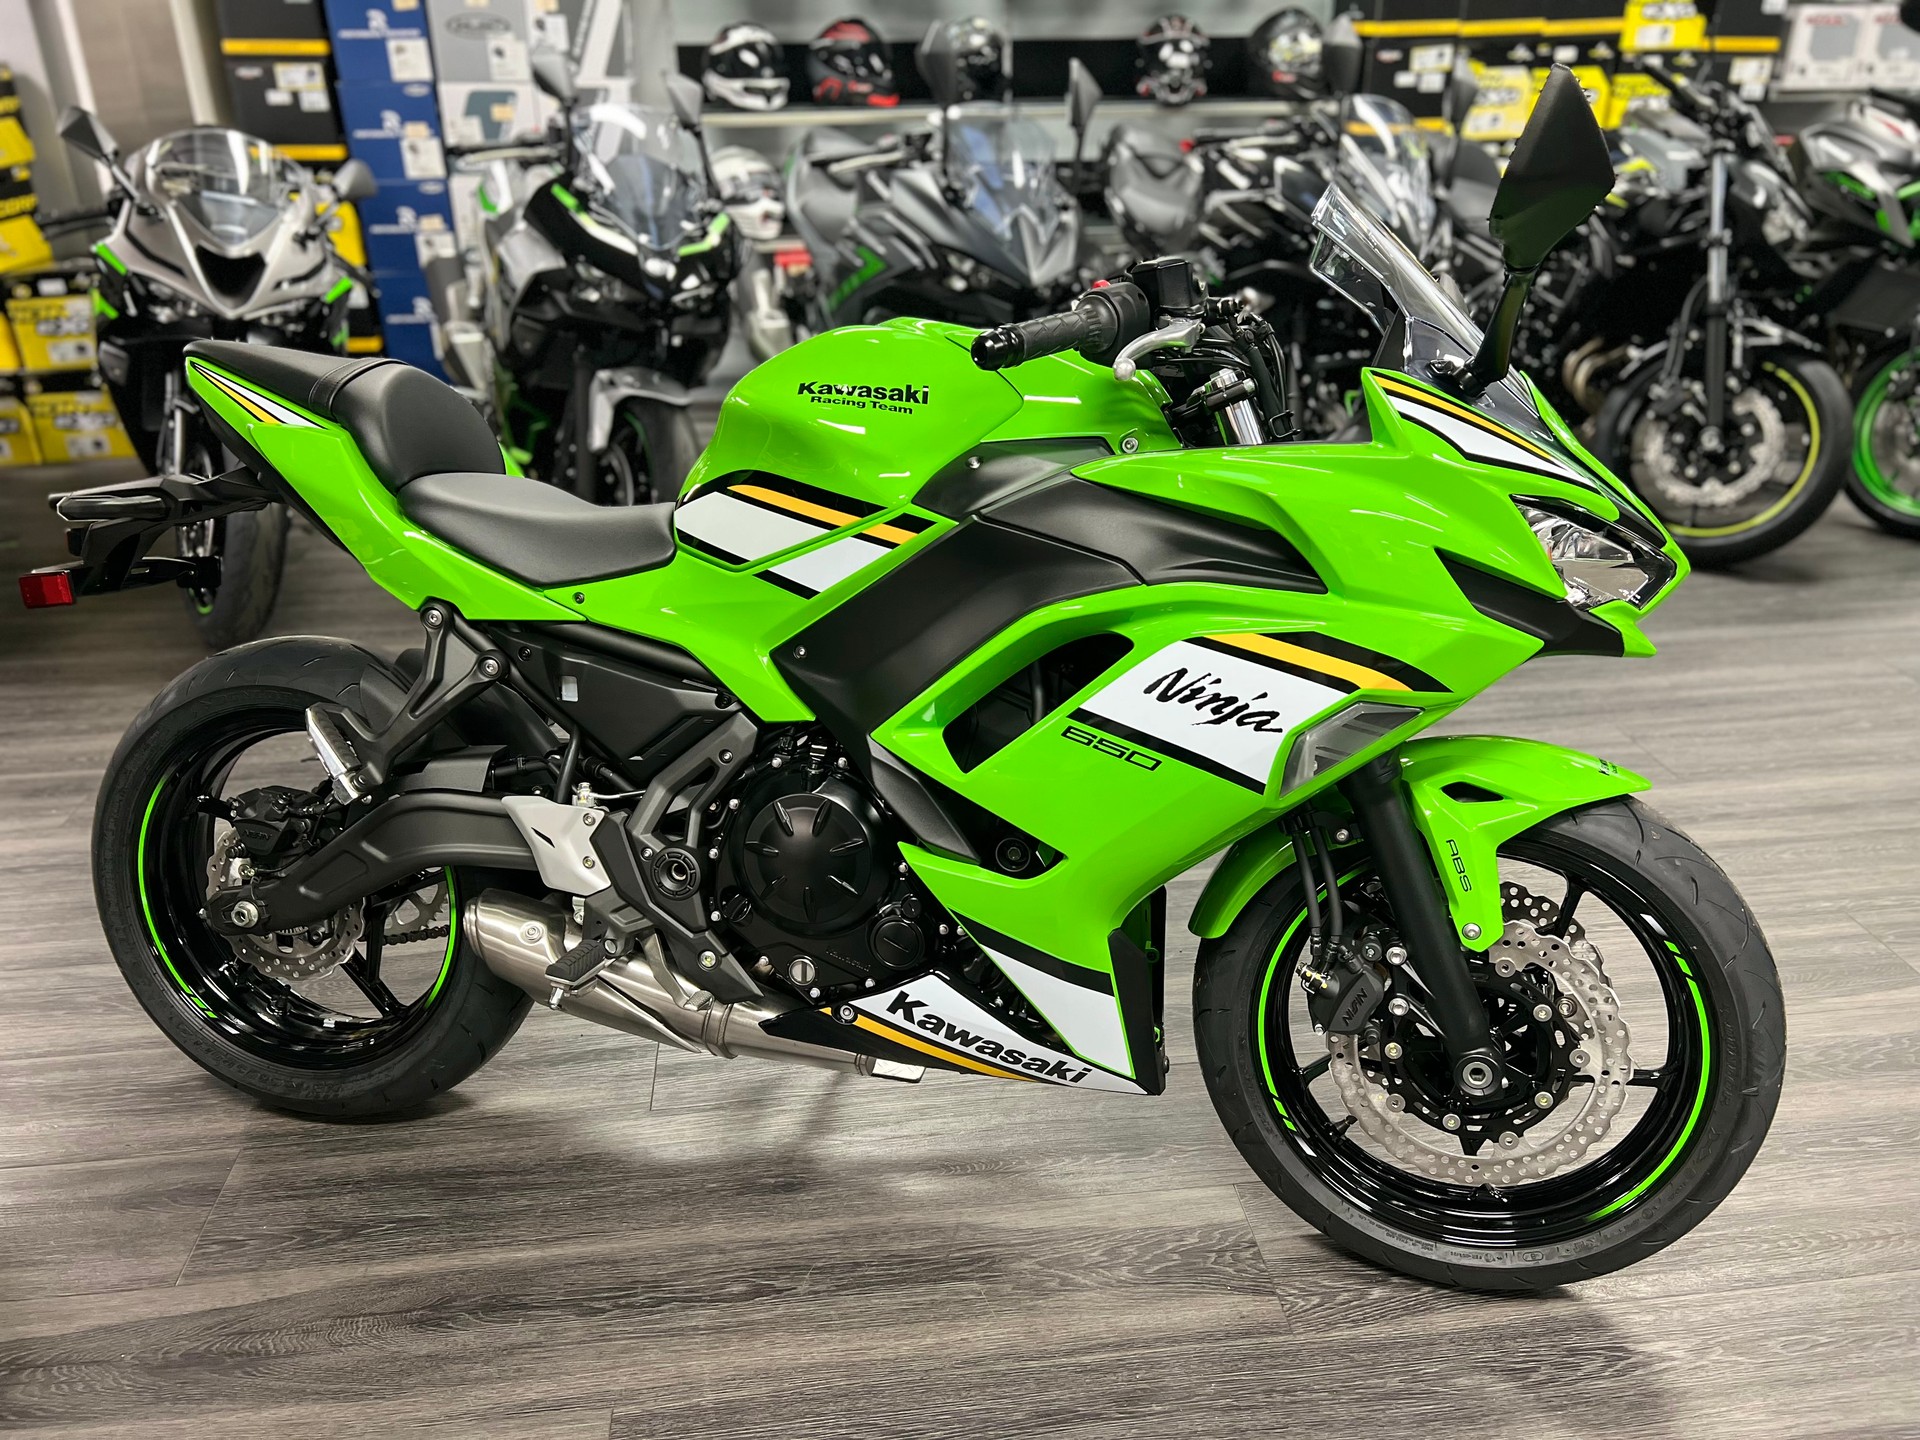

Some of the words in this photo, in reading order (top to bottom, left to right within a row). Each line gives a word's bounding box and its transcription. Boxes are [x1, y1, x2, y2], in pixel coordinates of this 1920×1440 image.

[798, 381, 929, 404] Kawasaki
[810, 396, 866, 409] Racing
[870, 400, 913, 414] Team
[1143, 667, 1283, 733] Ninja
[1061, 725, 1163, 772] 650
[1445, 838, 1472, 893] ABS
[885, 989, 1091, 1084] Kawasaki
